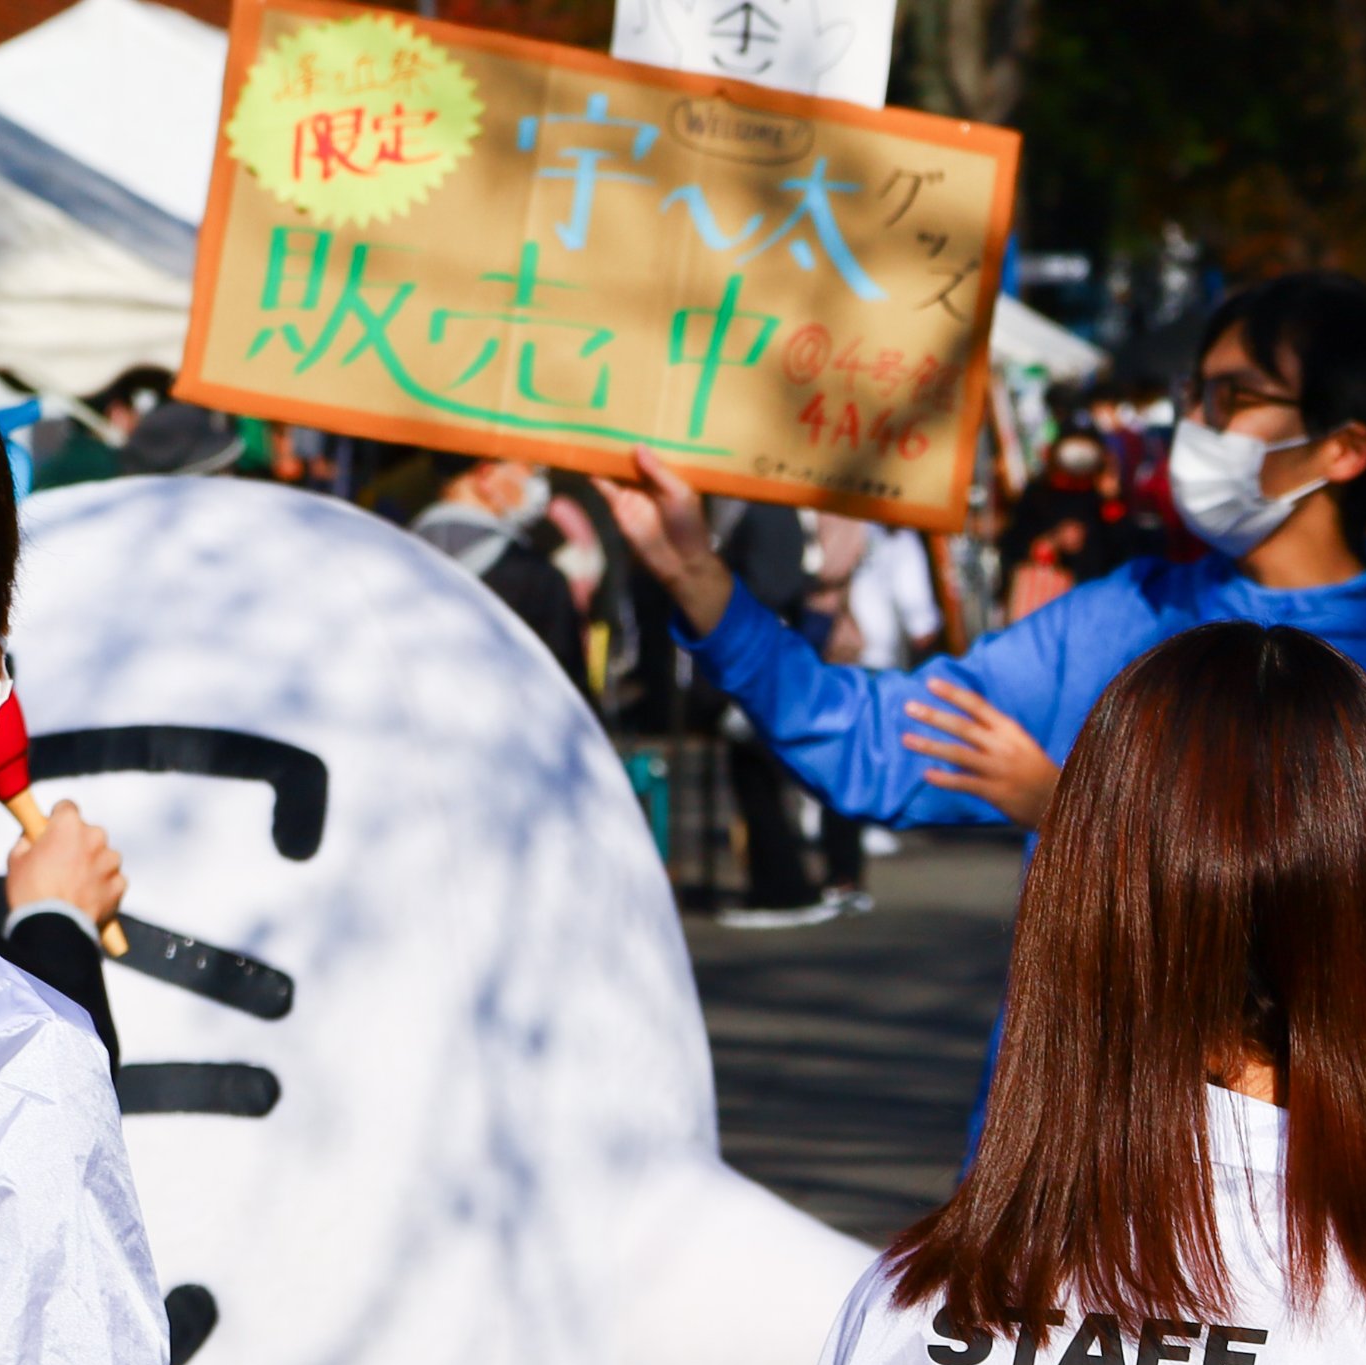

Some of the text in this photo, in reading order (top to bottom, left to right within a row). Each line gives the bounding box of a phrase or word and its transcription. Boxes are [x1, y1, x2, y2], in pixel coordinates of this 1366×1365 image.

[291, 102, 441, 182] 限定
[879, 166, 978, 323] グッズ
[246, 226, 781, 456] 販売中
